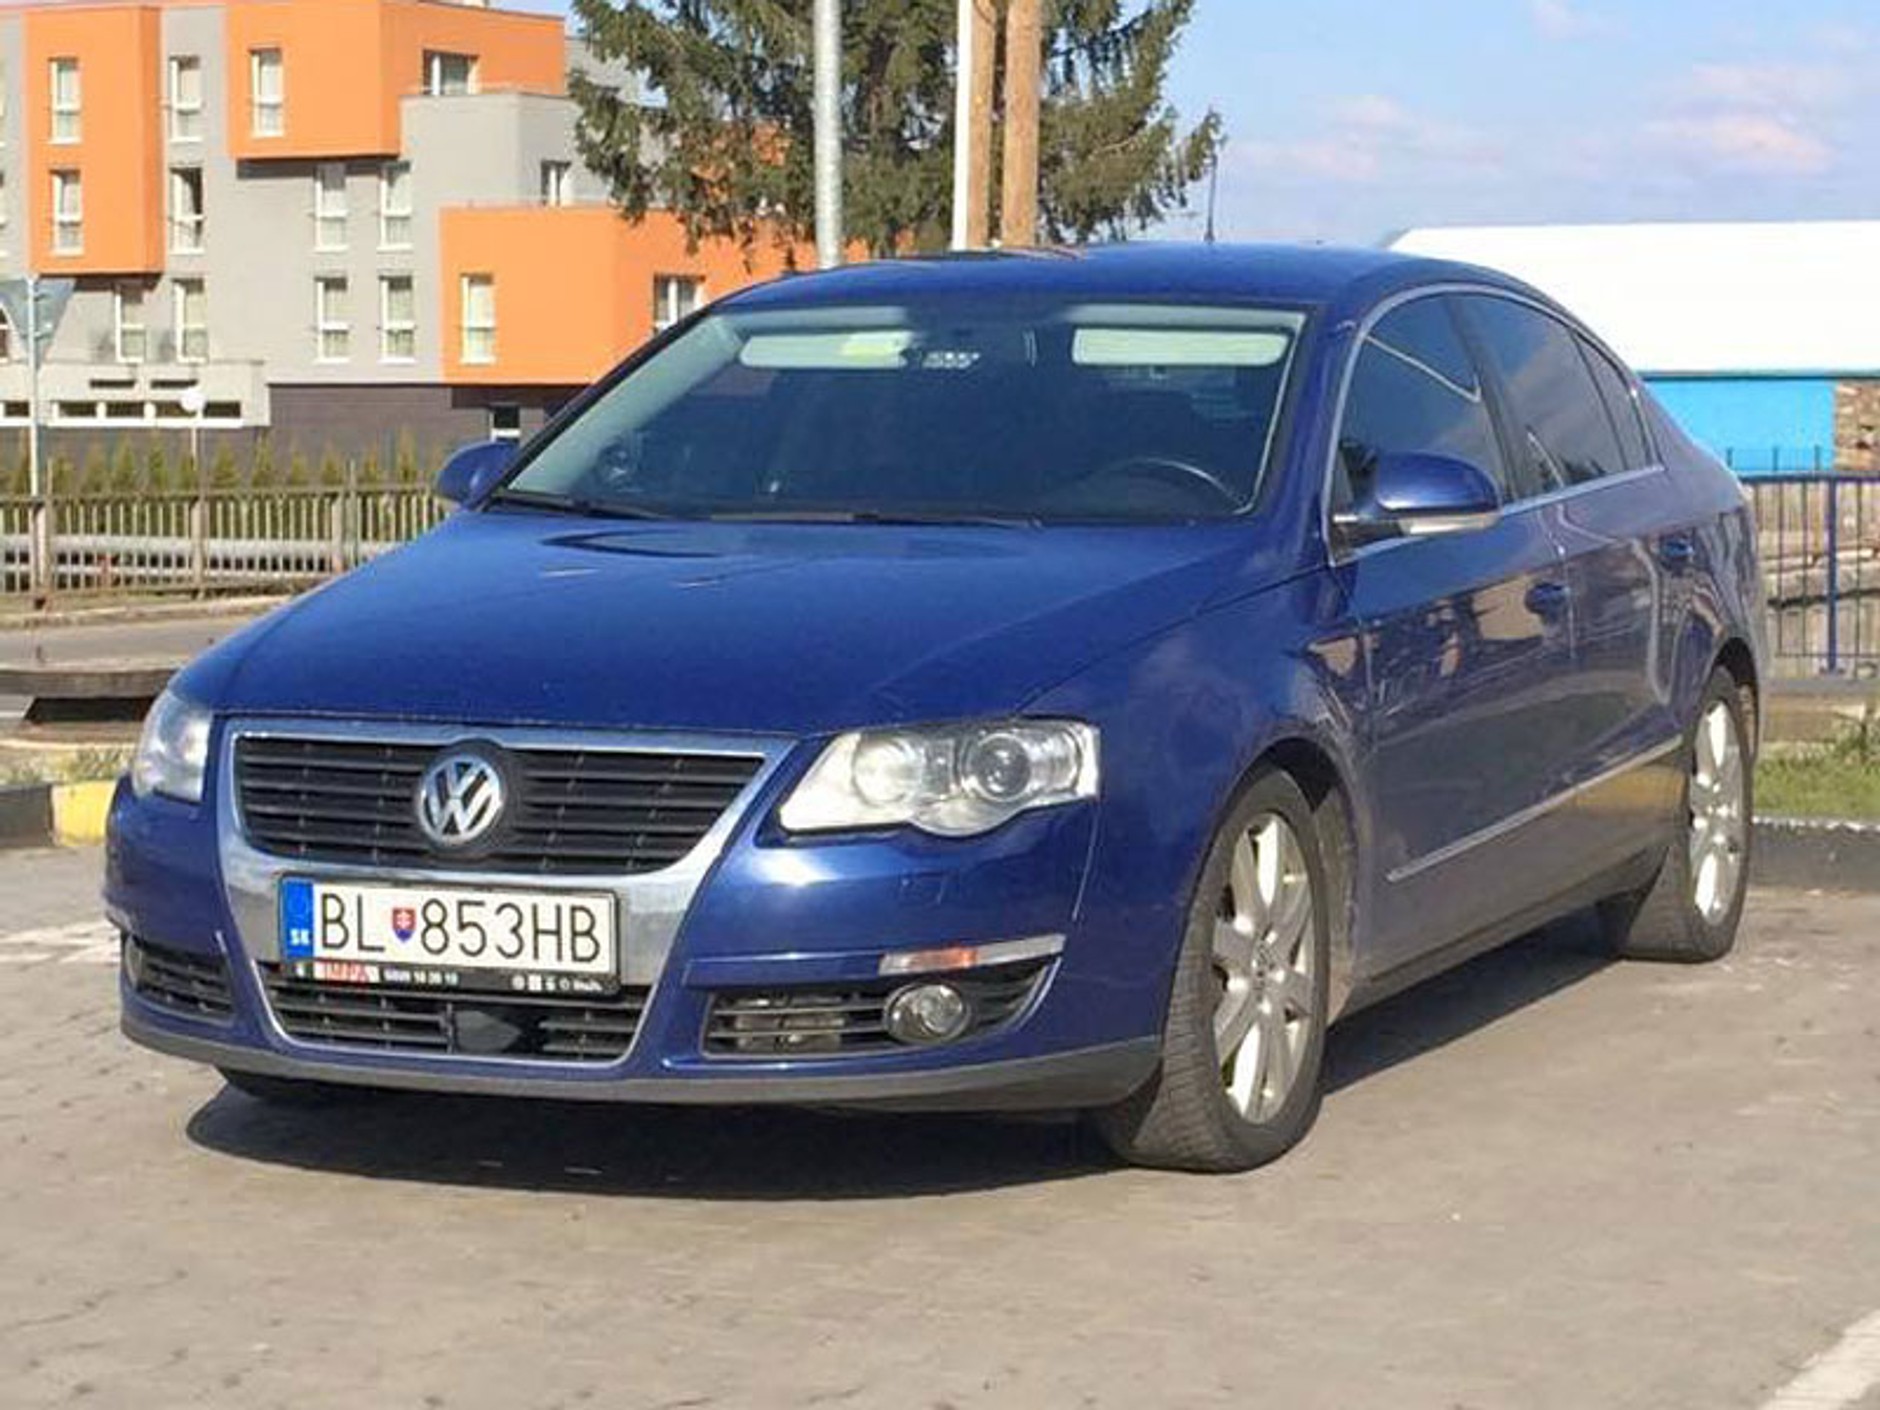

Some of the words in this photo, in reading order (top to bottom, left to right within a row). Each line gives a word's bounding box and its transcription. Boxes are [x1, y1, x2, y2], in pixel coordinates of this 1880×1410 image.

[420, 755, 501, 844] VW
[321, 893, 385, 951] BL
[420, 898, 600, 963] 853HB
